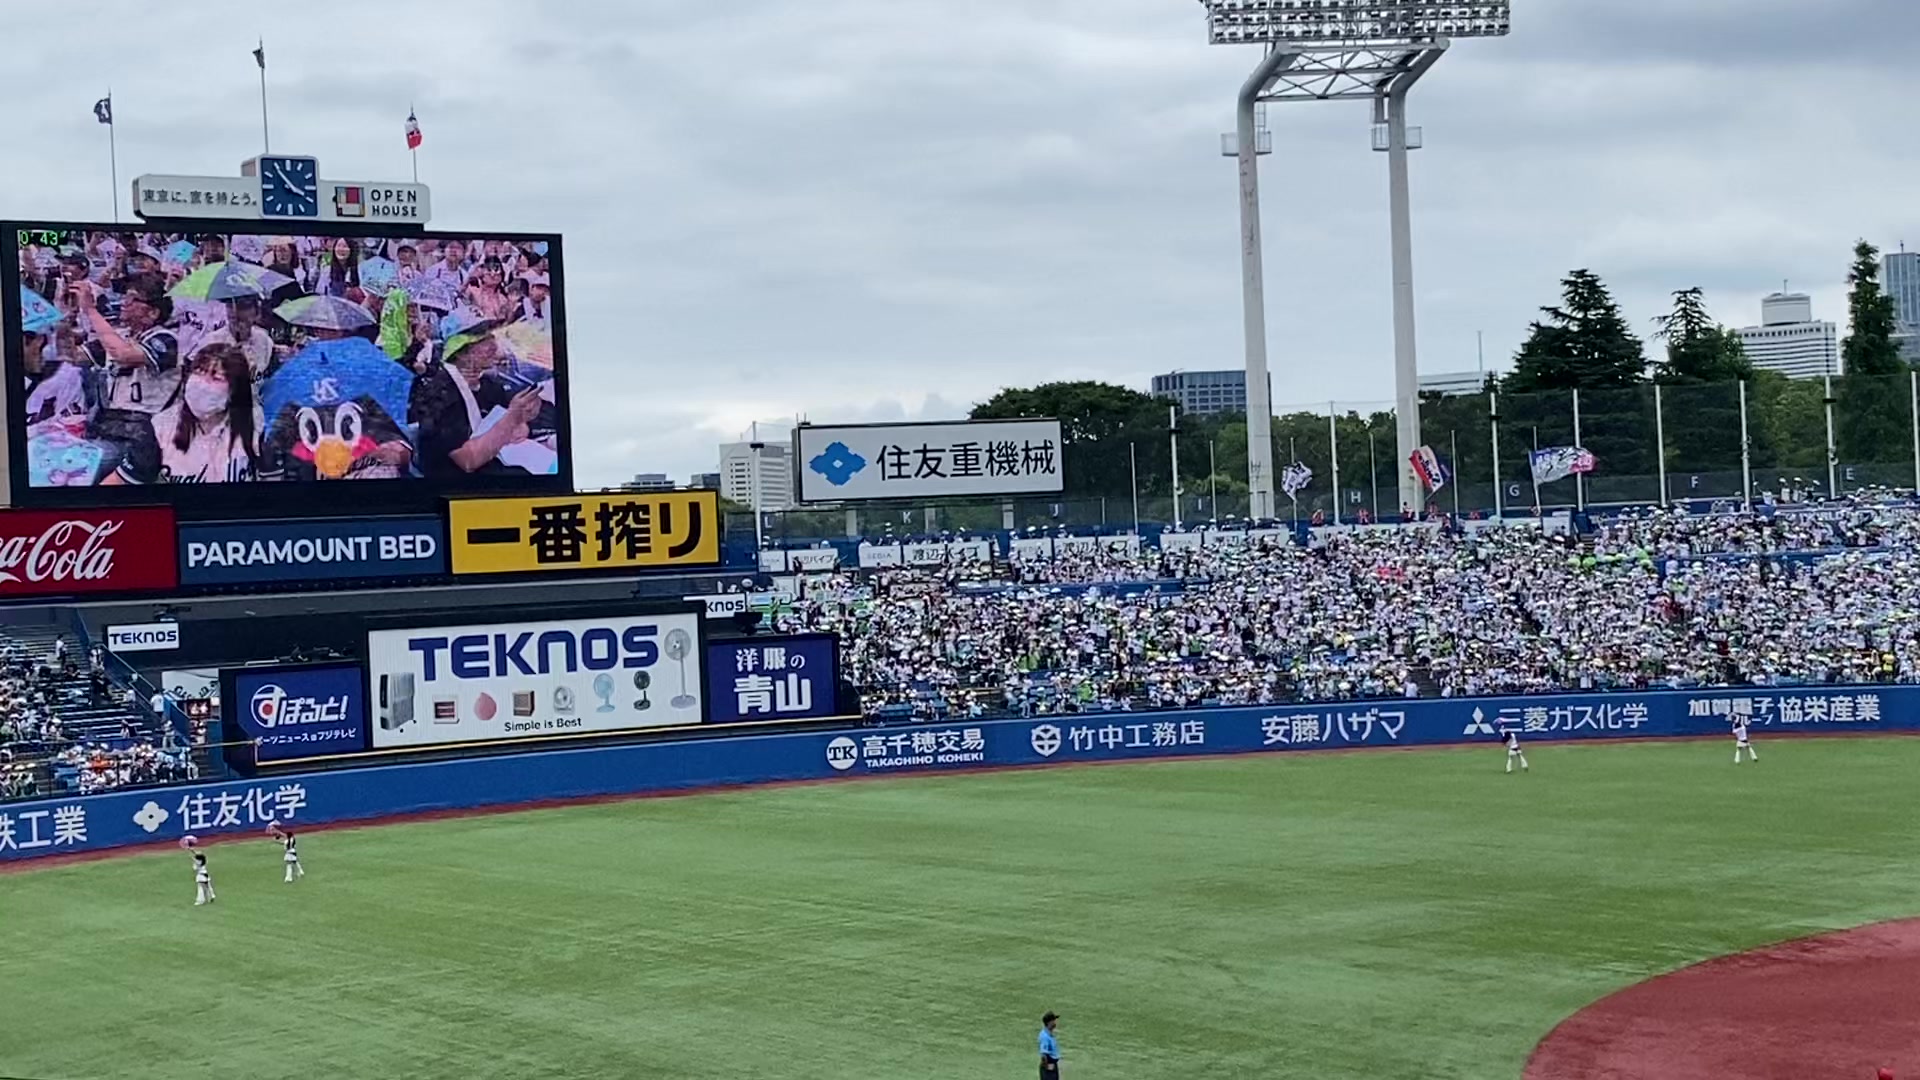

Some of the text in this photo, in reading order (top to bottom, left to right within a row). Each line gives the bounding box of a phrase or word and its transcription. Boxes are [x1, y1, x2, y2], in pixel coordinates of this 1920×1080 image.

[370, 189, 418, 202] OPEN
[371, 205, 418, 217] HOUSE
[876, 439, 1056, 481] 住友重機械
[1691, 476, 1699, 488] F
[1845, 468, 1855, 480] E
[1351, 491, 1361, 503] H
[1509, 484, 1520, 496] G
[764, 515, 773, 528] L
[903, 511, 911, 524] K
[467, 501, 701, 563] 一番搾り
[0, 520, 124, 581] a-Cola
[187, 534, 436, 568] PARAMOUNT BED
[109, 630, 177, 645] TEKNOS
[408, 625, 659, 681] TEKNOS
[735, 647, 806, 672] 洋服の
[733, 672, 812, 715] 青山
[1499, 703, 1649, 734] 三菱ガス化学
[1778, 694, 1881, 723] 協栄産業
[504, 716, 582, 732] Simple is Best
[1068, 720, 1204, 751] 竹中工務店
[1261, 709, 1405, 745] 安藤ハザマ
[828, 746, 857, 761] TK
[862, 728, 985, 757] 高千穂交易
[865, 752, 983, 769] TAKACHIHO KOHEKI
[177, 784, 307, 831] 住友化学
